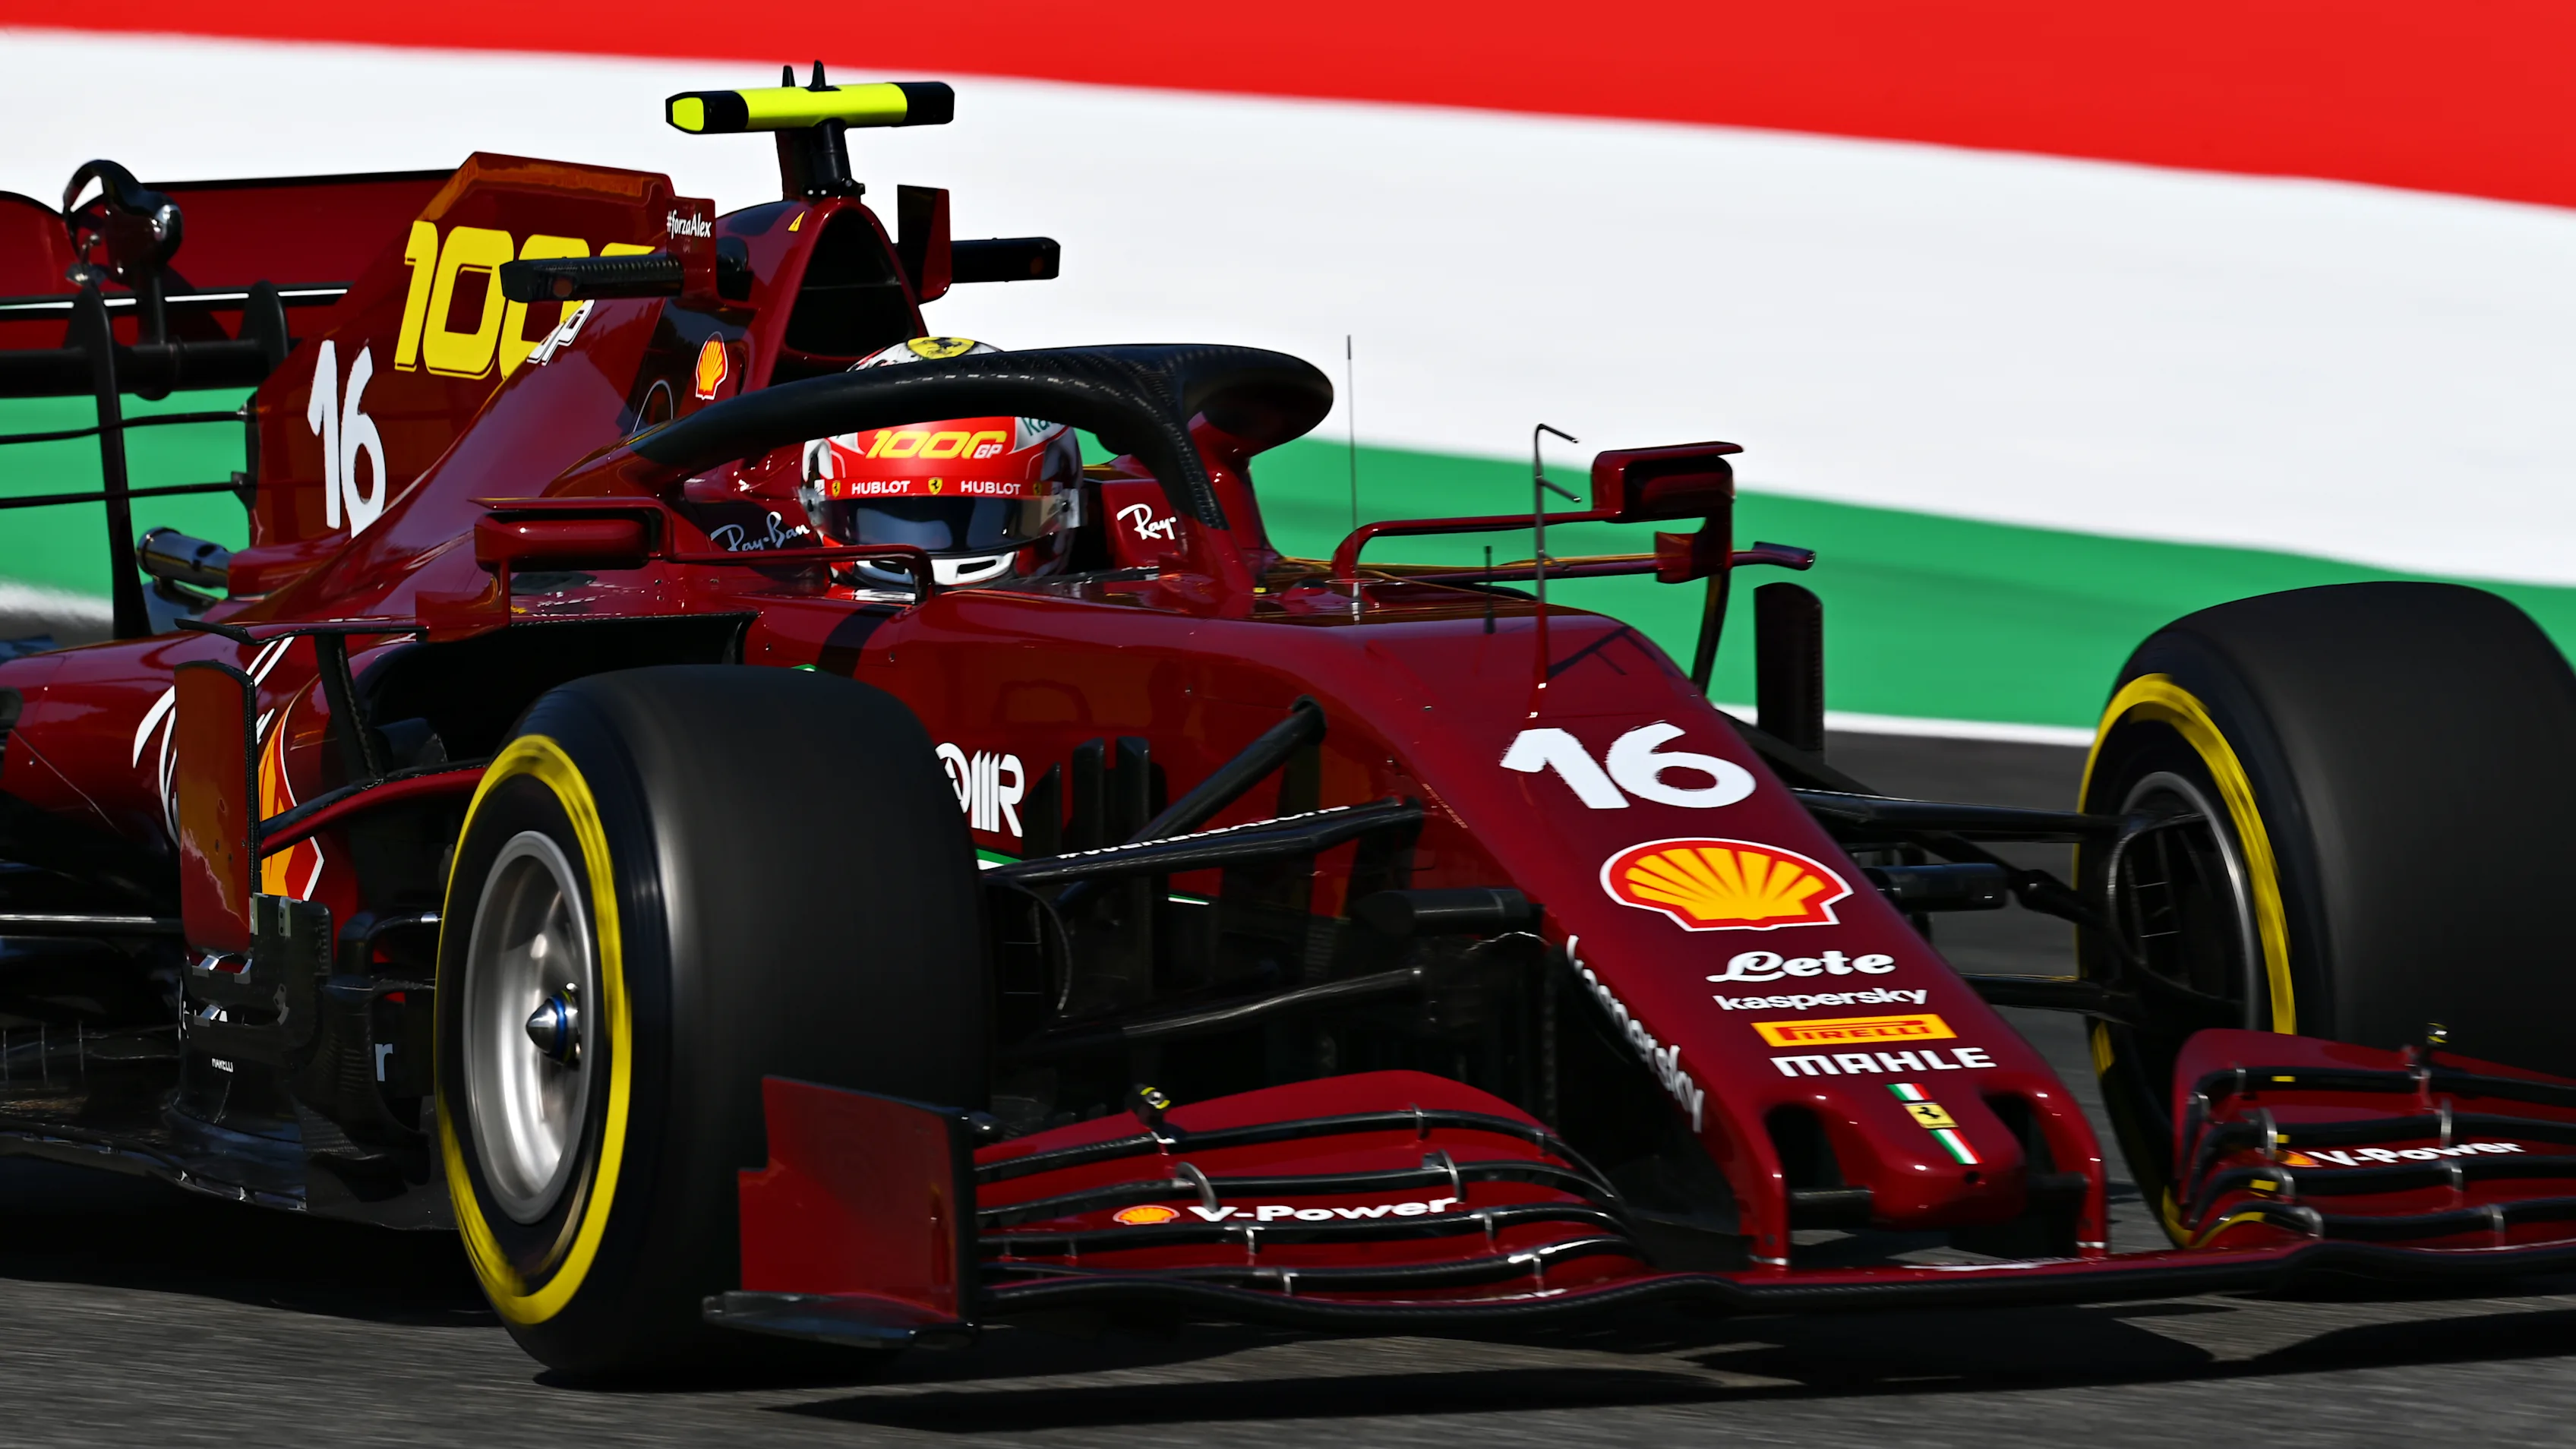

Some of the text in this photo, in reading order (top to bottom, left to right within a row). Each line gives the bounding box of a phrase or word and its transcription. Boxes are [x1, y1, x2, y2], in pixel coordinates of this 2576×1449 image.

[666, 209, 712, 240] #forzaAlex
[307, 339, 387, 538] 16
[973, 444, 1003, 459] GP
[851, 479, 911, 495] HUBLOT
[960, 479, 1022, 496] HUBLOT
[710, 510, 810, 552] Ray-Ban
[1499, 719, 1756, 809] 16
[1706, 950, 1896, 982] Lete
[1712, 987, 1927, 1010] kaspersky
[1772, 1019, 1931, 1041] PIRELLI
[1769, 1046, 1998, 1078] MAHLE
[2303, 1142, 2527, 1166] V-Power
[1187, 1197, 1458, 1223] V-Power
